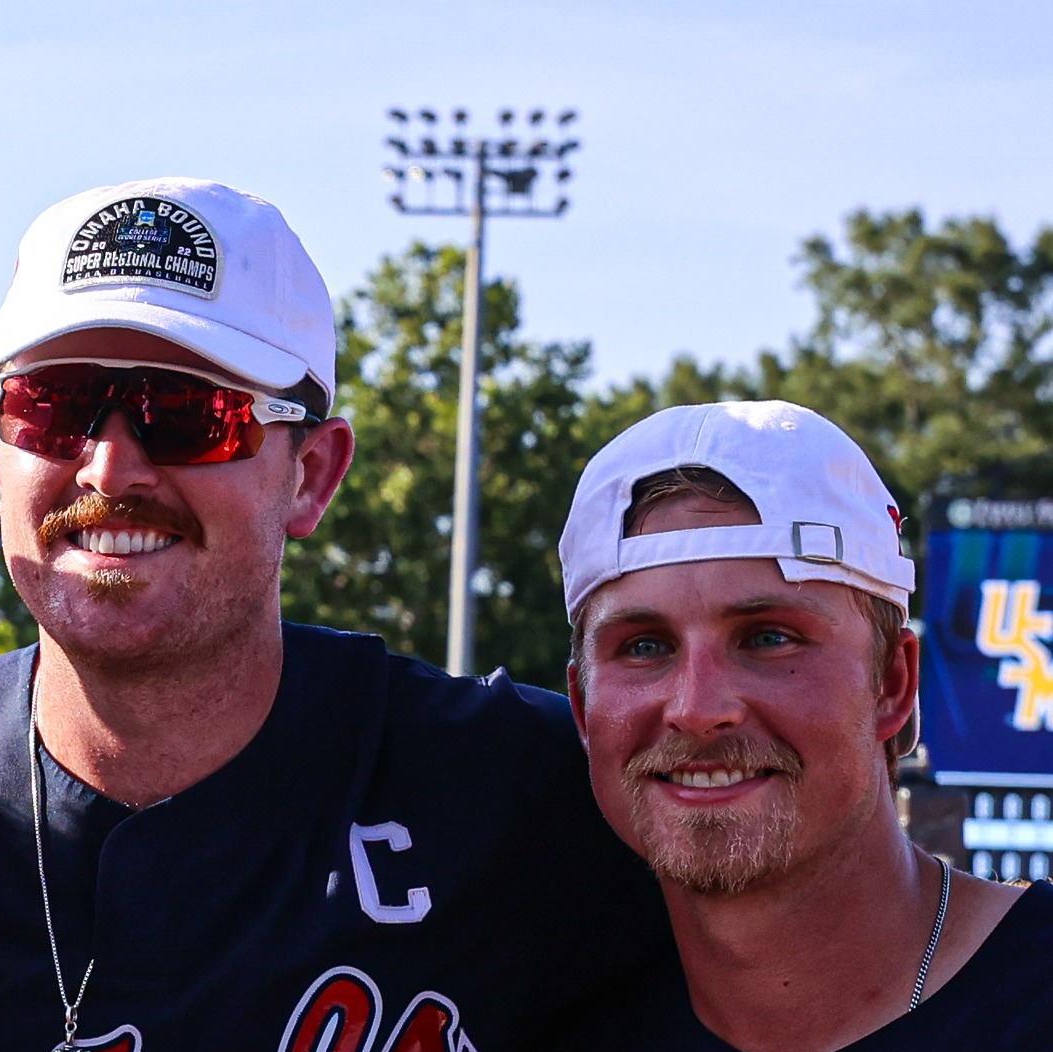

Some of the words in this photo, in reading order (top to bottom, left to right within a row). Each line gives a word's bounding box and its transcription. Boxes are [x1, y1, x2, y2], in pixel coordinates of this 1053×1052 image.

[71, 200, 145, 251] OMAHA
[158, 202, 214, 259] BOUND
[92, 241, 107, 251] 20
[177, 246, 192, 257] 22
[66, 252, 101, 275] SUPER
[103, 251, 162, 269] REGIONAL
[165, 255, 214, 282] CHAMPS
[349, 820, 432, 924] C
